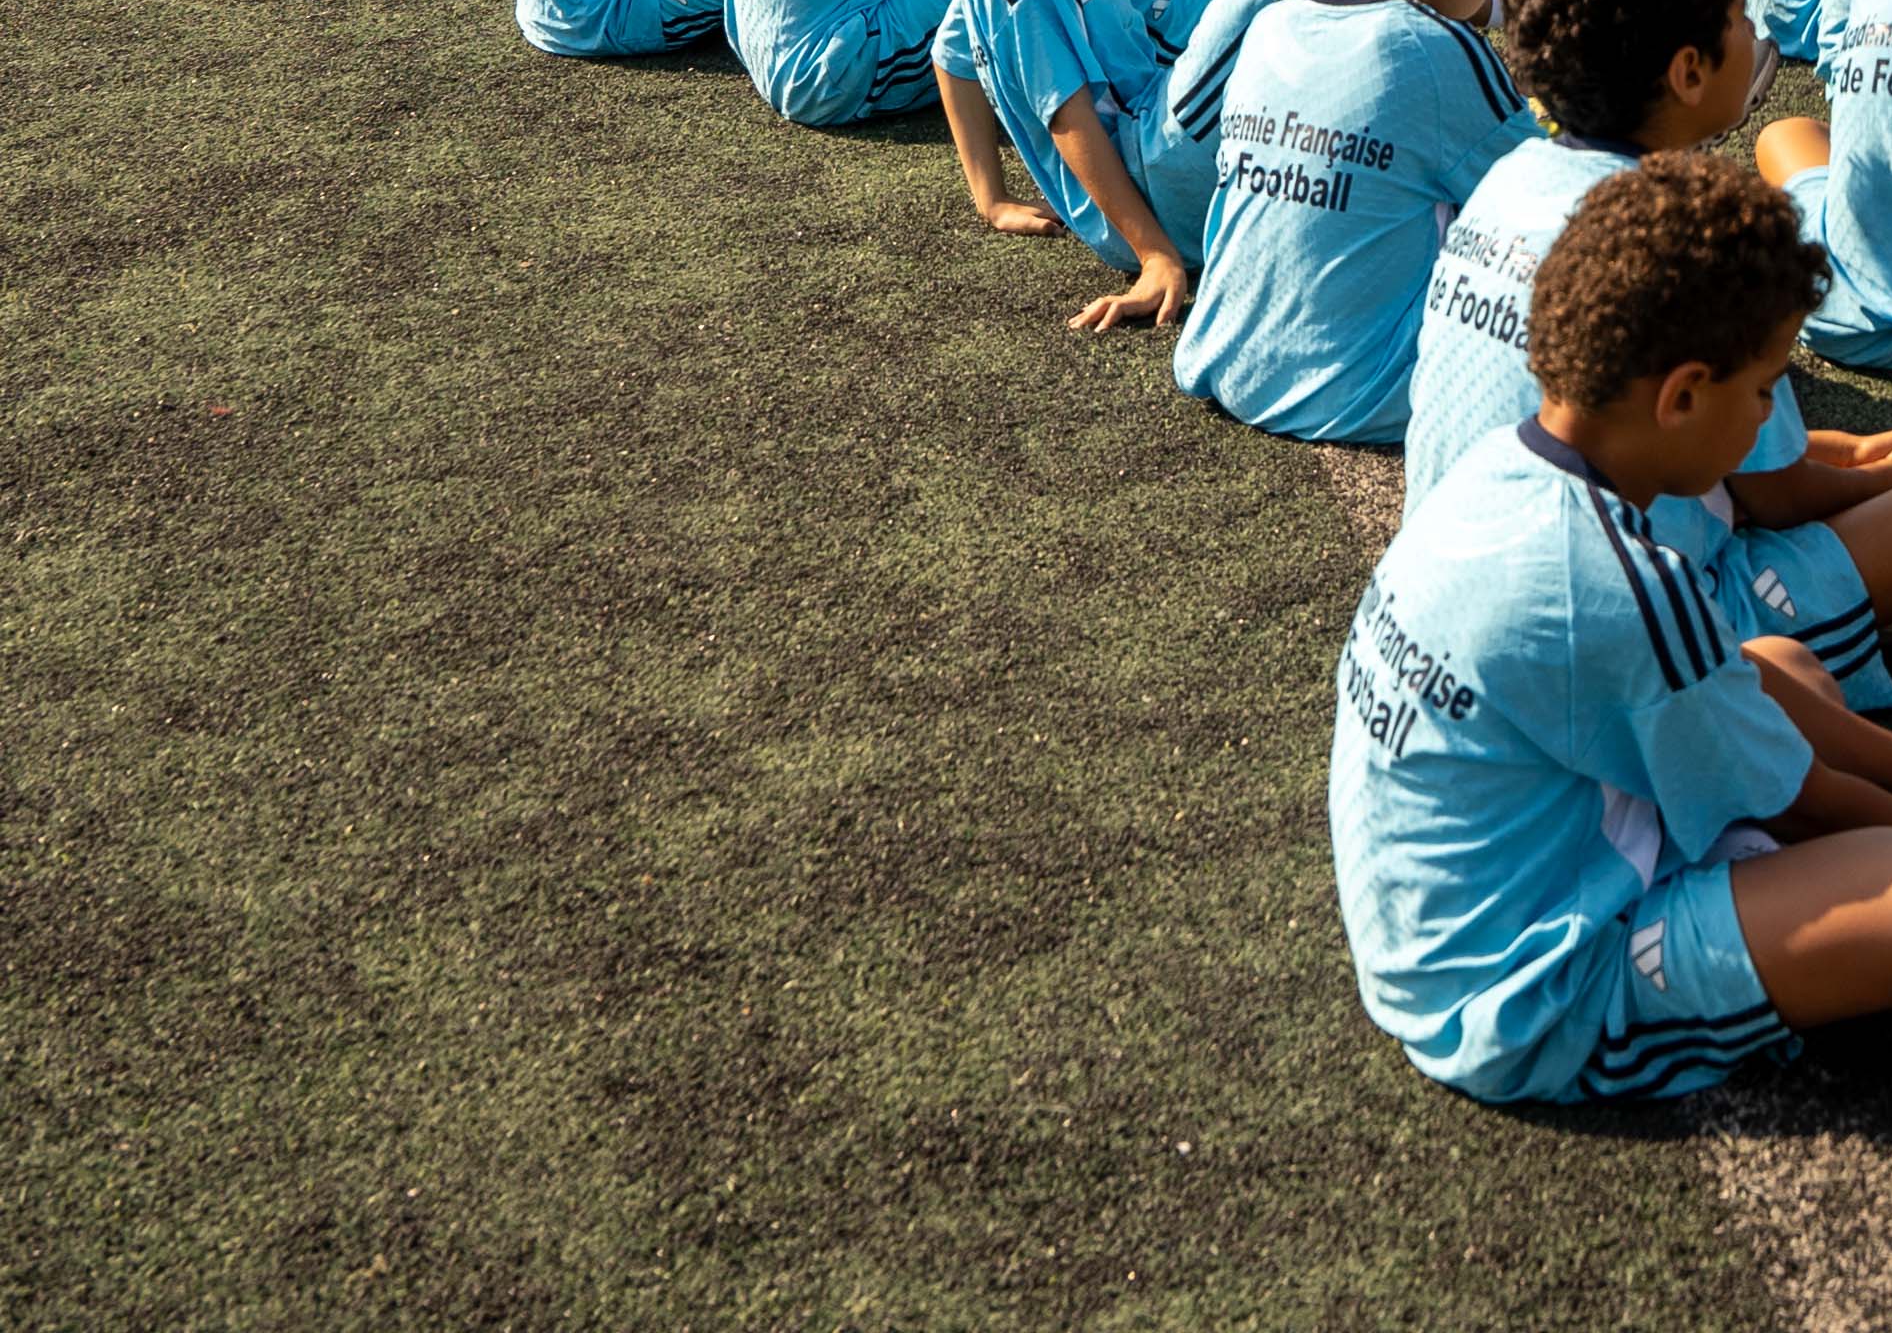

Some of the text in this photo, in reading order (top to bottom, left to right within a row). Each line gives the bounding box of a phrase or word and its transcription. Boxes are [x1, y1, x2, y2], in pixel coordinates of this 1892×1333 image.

[1280, 110, 1395, 172] Française
[1237, 152, 1354, 213] Football
[1446, 274, 1530, 353] Footba
